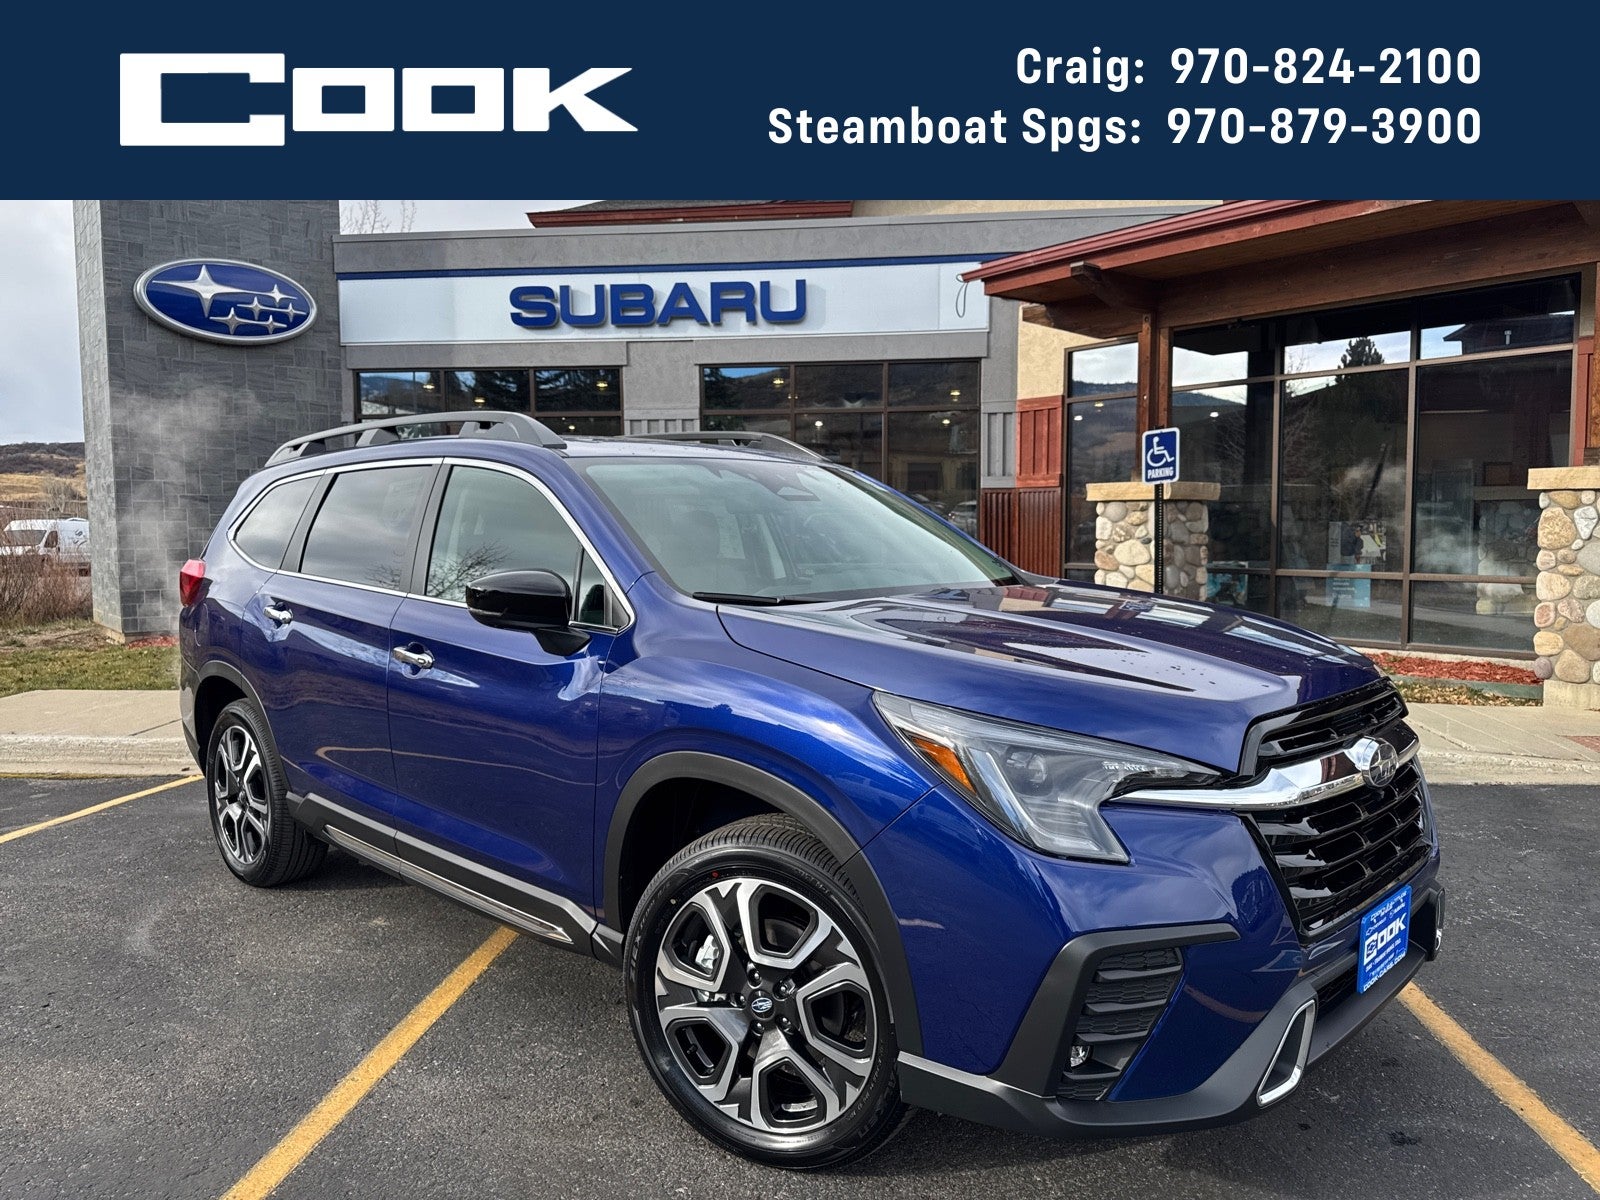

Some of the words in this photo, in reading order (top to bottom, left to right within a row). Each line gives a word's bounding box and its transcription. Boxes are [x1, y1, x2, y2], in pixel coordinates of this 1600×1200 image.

[510, 279, 806, 328] SUBARU
[1147, 467, 1174, 479] PARKING
[1364, 912, 1407, 966] COOK
